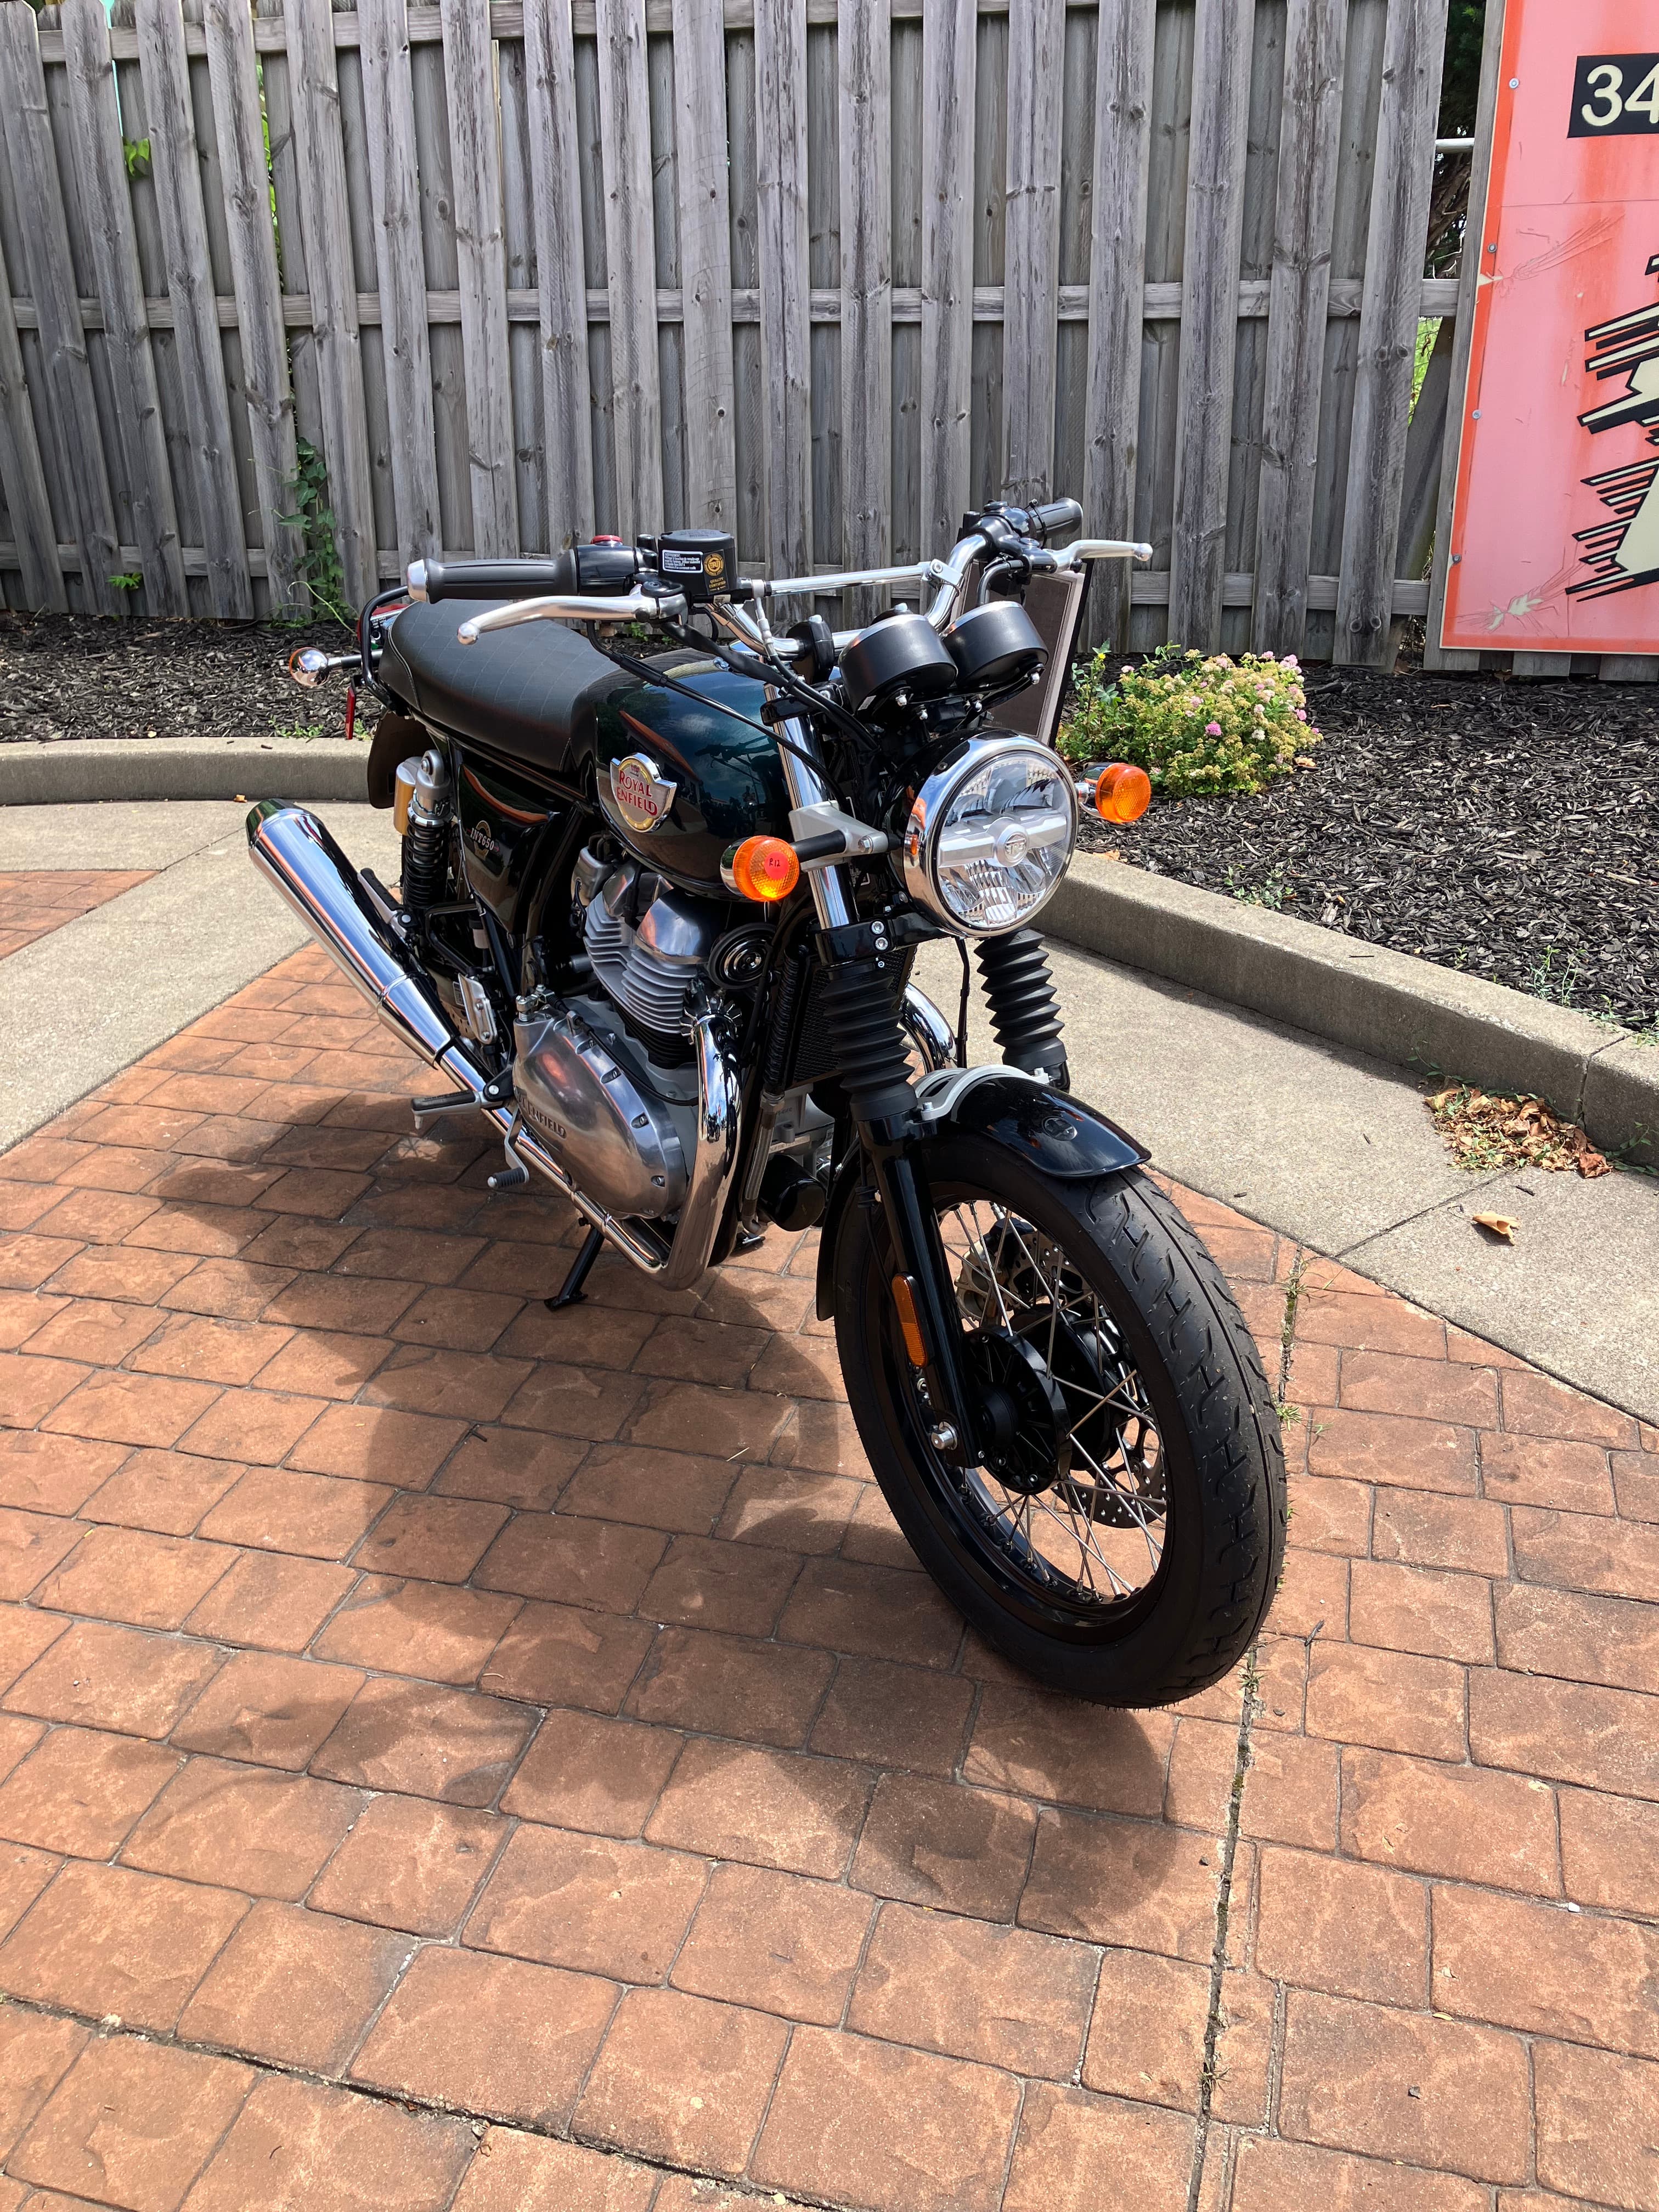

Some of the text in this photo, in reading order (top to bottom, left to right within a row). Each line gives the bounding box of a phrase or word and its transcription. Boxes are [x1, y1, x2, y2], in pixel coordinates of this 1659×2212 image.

[1582, 63, 1659, 126] 34
[619, 770, 652, 797] ROYAL
[617, 787, 658, 816] ENFIELD
[470, 827, 495, 850] INT650
[769, 857, 781, 867] R12
